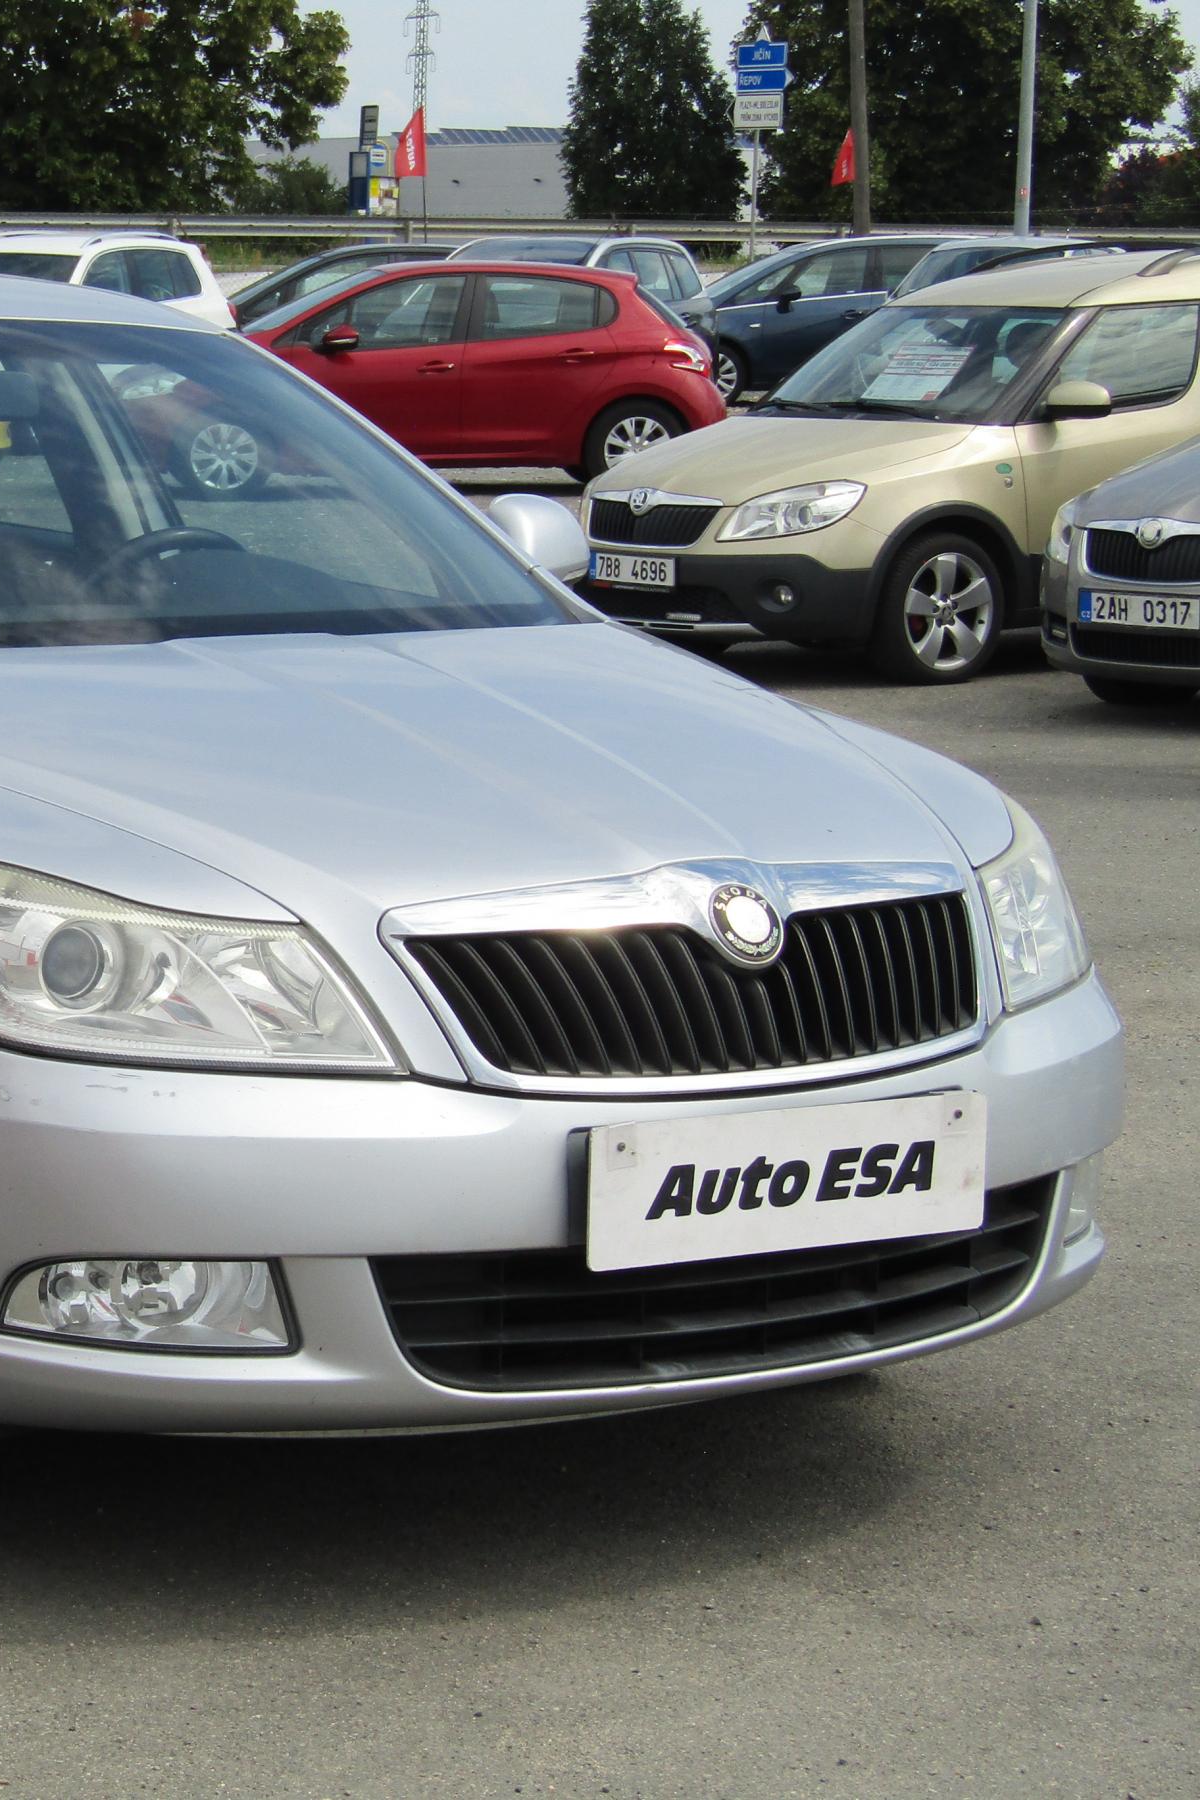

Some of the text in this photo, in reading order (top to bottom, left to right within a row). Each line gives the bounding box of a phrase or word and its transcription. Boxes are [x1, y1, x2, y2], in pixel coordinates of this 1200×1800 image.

[599, 555, 666, 582] 7B8 4696
[1081, 610, 1091, 618] CZ
[1096, 596, 1191, 625] 2AH 0317
[645, 1140, 936, 1221] Auto ESA
